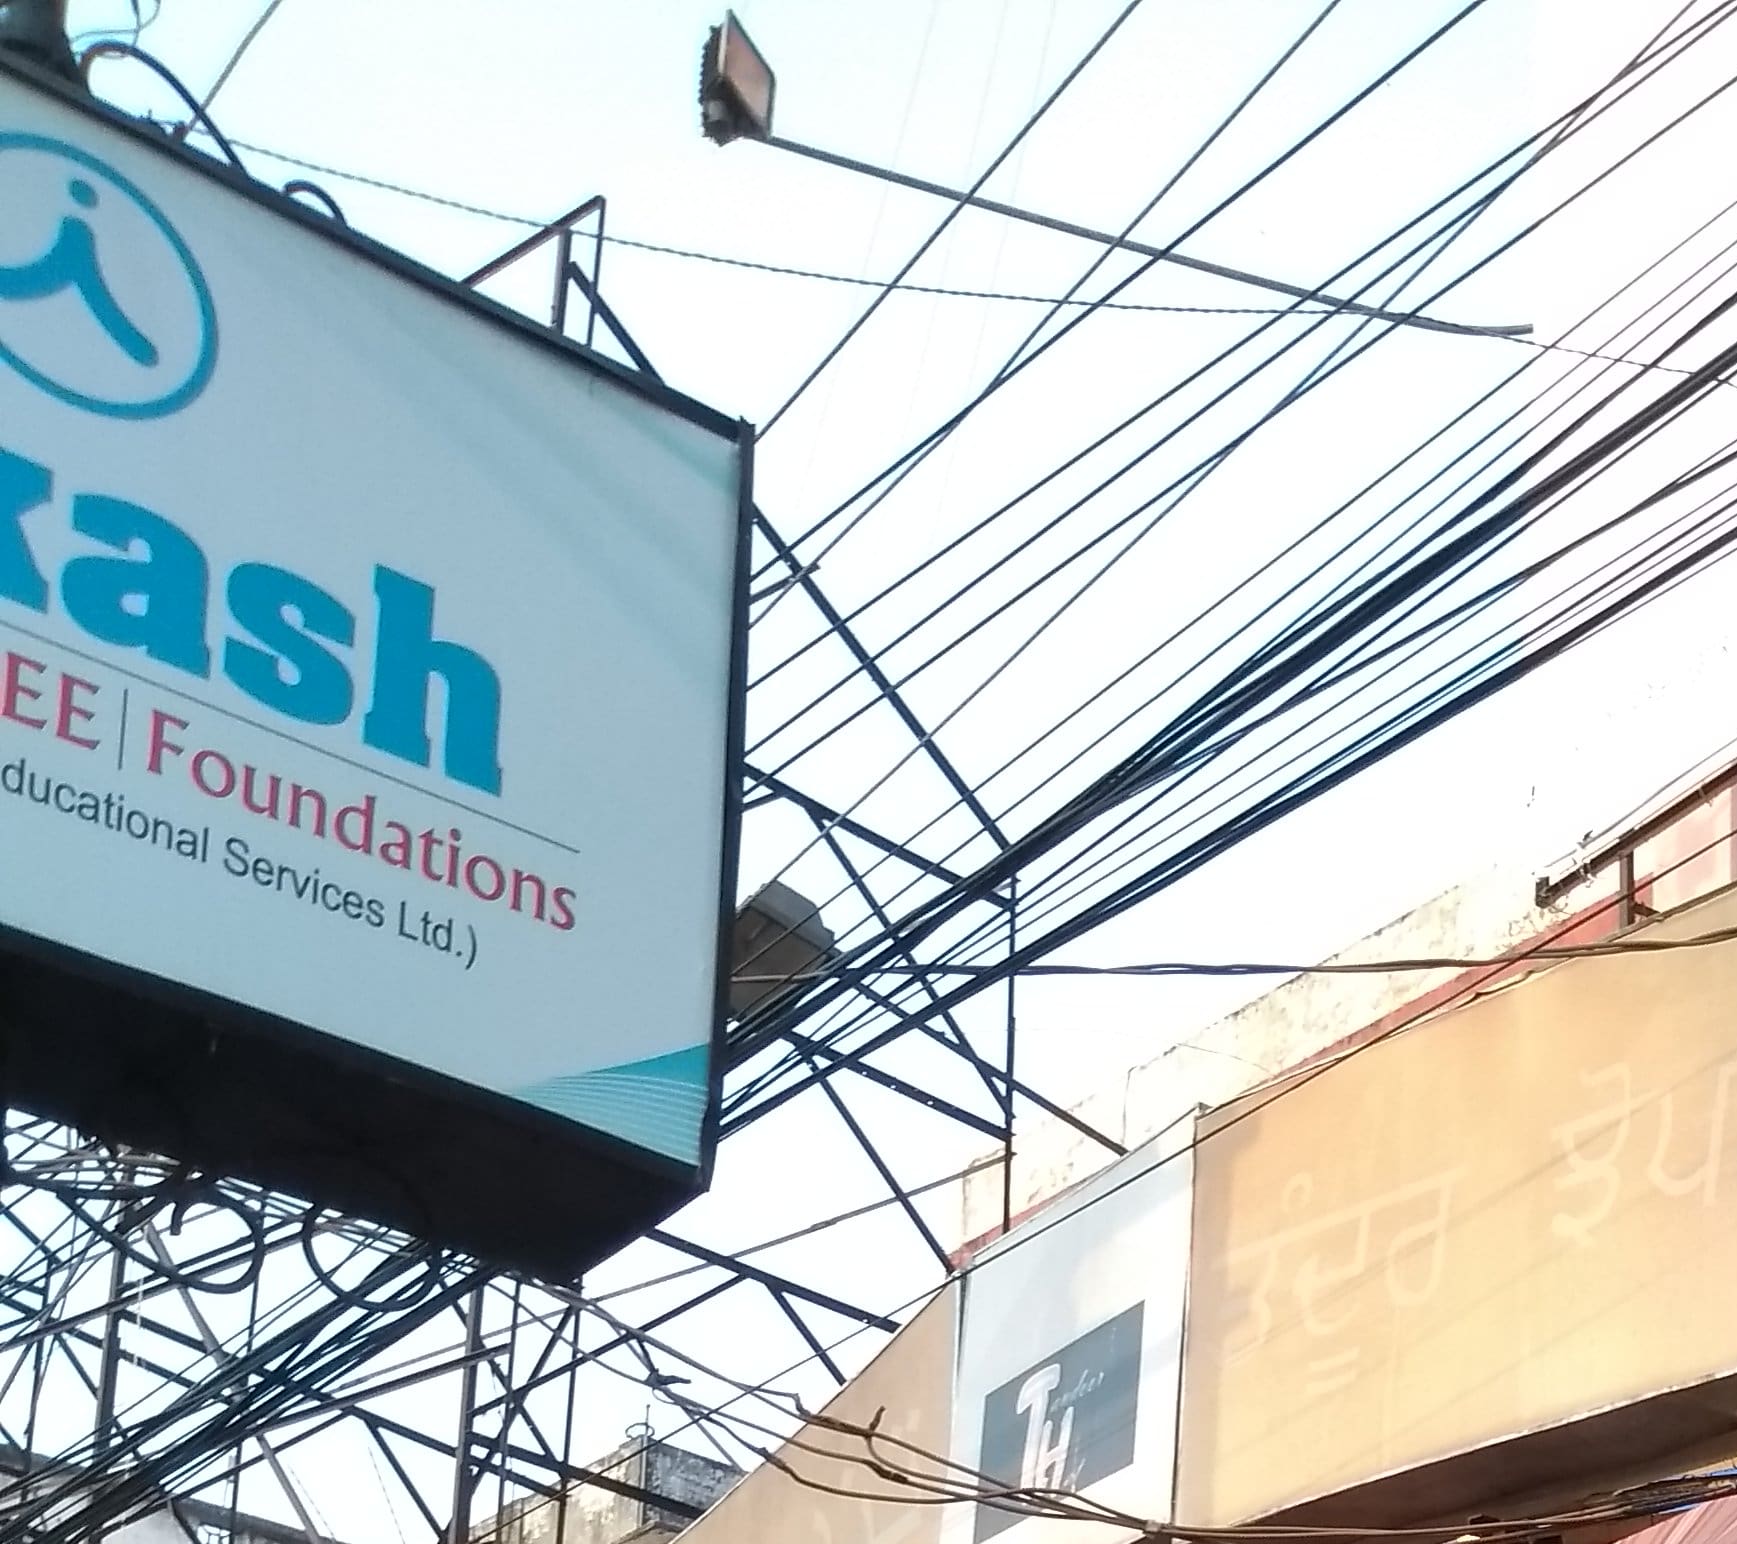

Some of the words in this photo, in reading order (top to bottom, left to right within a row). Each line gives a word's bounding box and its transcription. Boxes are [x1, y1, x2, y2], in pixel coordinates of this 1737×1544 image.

[0, 651, 101, 750] EE
[146, 709, 578, 931] Foundations
[1, 758, 209, 863] ducational
[223, 836, 385, 927] Services
[397, 900, 478, 970] Ltd.)
